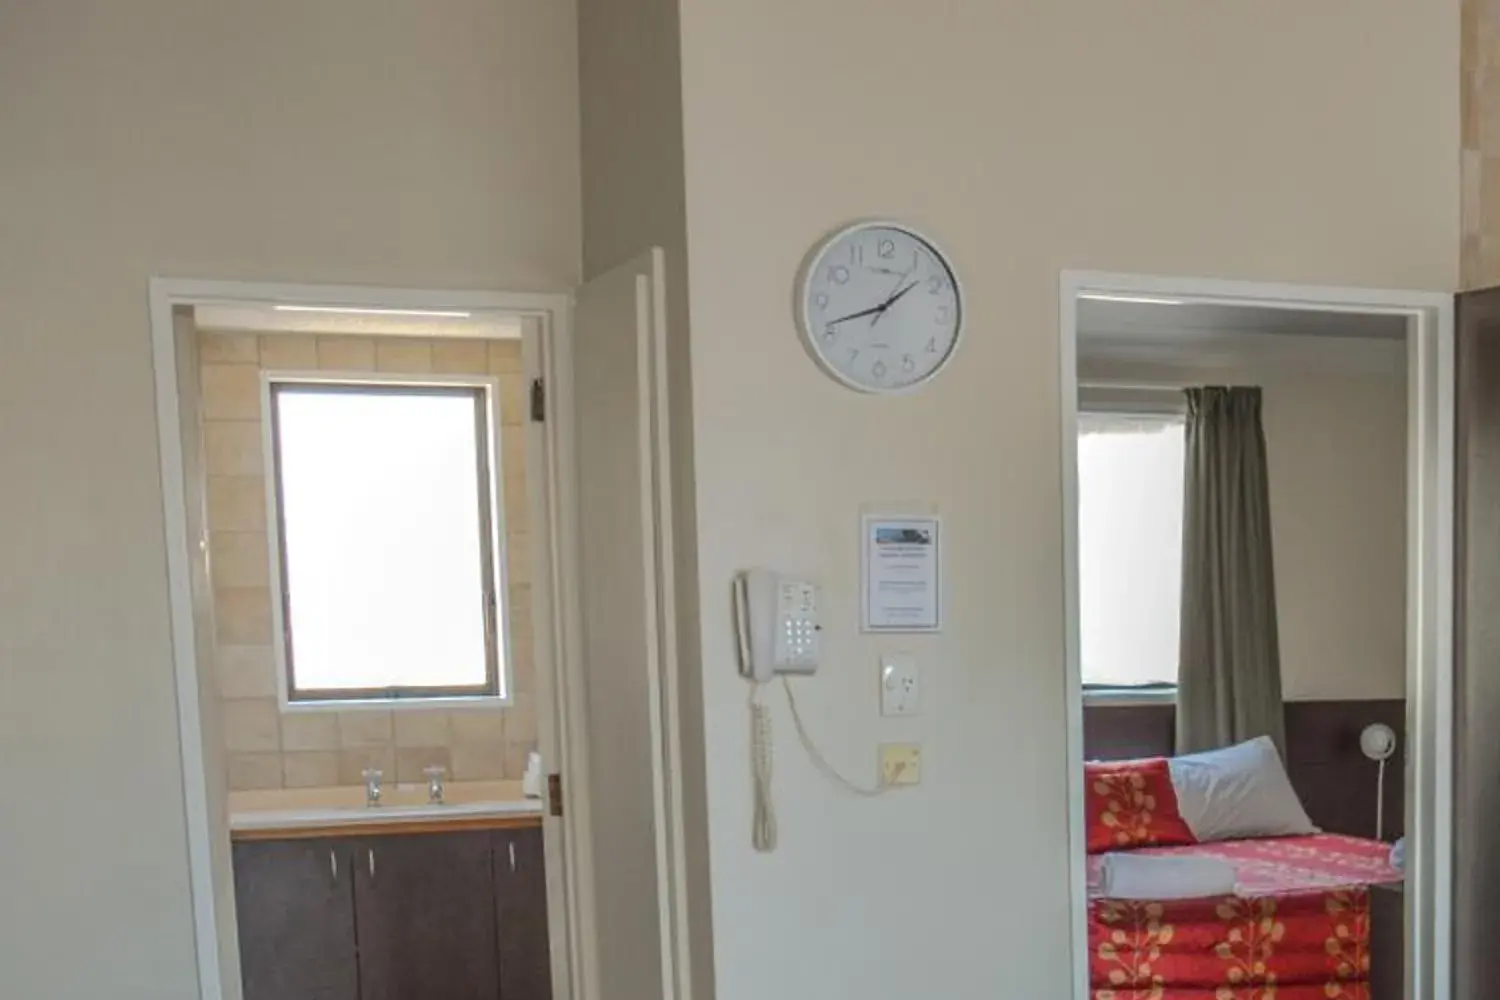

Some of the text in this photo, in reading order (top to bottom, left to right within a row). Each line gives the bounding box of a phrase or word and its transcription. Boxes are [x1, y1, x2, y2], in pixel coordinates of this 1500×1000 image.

[850, 245, 863, 267] 11
[877, 239, 895, 259] 12
[912, 250, 918, 272] 1
[827, 264, 850, 285] 10
[928, 276, 942, 295] 2
[816, 294, 829, 311] 9
[935, 306, 948, 325] 3
[925, 336, 938, 354] 4
[847, 348, 860, 364] 7
[901, 353, 915, 373] 5
[871, 358, 887, 378] 6
